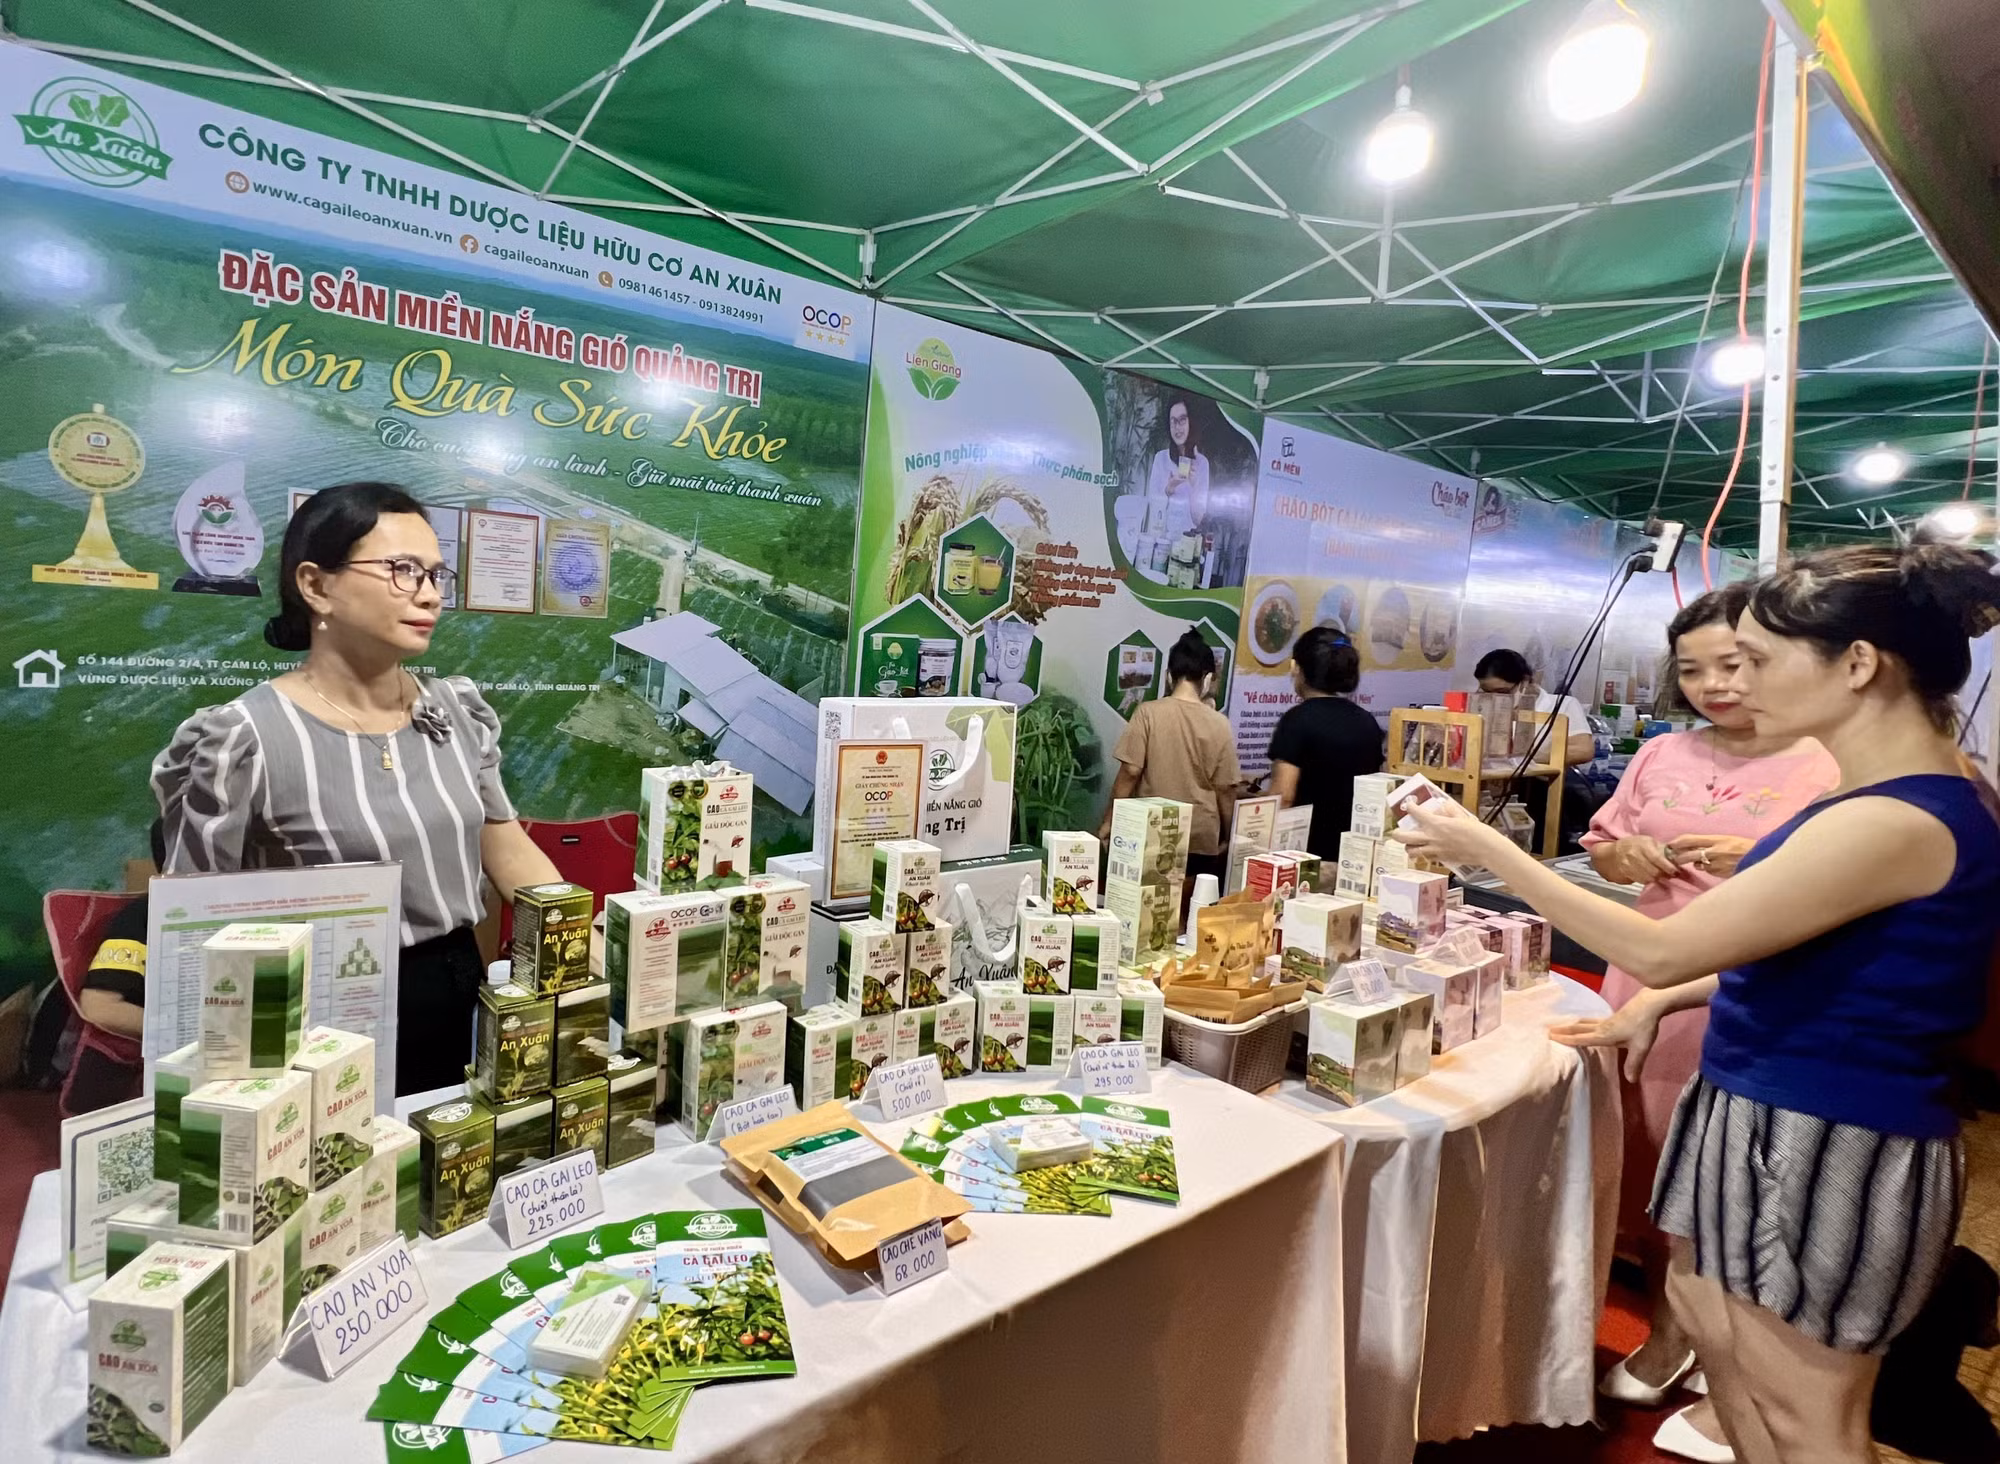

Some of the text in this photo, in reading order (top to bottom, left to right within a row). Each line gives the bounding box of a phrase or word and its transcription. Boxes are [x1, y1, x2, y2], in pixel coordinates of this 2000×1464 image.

[26, 120, 164, 172] An Xuân
[199, 123, 782, 304] CÔNG TY TNHH DƯỢC LIỆU HỮU CƠ AN XUÂN
[253, 179, 764, 324] www.cagaileoanxuan.vn cagaileoanxuan 0981461457 0913824991
[802, 305, 852, 331] OCOP
[221, 252, 760, 407] ĐẶC SẢN MIỀN NẮNG GIÓ QUẢNG TRỊ
[931, 359, 961, 378] Giang
[169, 317, 787, 463] Món Quà Sức Khỏe
[904, 452, 941, 473] Nông
[944, 443, 987, 468] nghiệp
[1061, 464, 1092, 482] phẩm
[1094, 470, 1119, 487] sạch
[737, 481, 780, 502] thanh
[101, 657, 123, 666] 144
[865, 790, 893, 801] OCOP
[706, 804, 720, 814] CAO
[944, 817, 966, 834] Trị
[1059, 855, 1070, 864] CAO
[671, 907, 697, 919] OCOP
[544, 928, 588, 945] An Xuân
[1031, 935, 1042, 943] CAO
[204, 996, 219, 1005] CAO
[500, 1033, 549, 1053] An Xuân
[1080, 1050, 1096, 1060] CAO
[1126, 1047, 1139, 1057] LEO
[879, 1060, 934, 1084] CAO GAI LEO
[1094, 1075, 1133, 1087] 295 000
[326, 1099, 343, 1117] CAO
[724, 1091, 790, 1121] CAO GAI LEO
[892, 1089, 931, 1113] 500 000
[560, 1117, 604, 1139] An Xuân
[267, 1142, 282, 1161] CAO
[440, 1154, 490, 1182] An Xuân
[506, 1183, 530, 1204] CAO
[551, 1169, 570, 1187] GAI
[572, 1160, 593, 1180] LEO
[527, 1198, 586, 1236] 225.000
[309, 1231, 327, 1250] CAO
[683, 1255, 699, 1266] CÀ
[727, 1254, 748, 1264] LEO
[881, 1244, 899, 1264] CAO
[895, 1250, 935, 1282] 68.000
[311, 1249, 412, 1331] CAO AN XOA
[336, 1280, 413, 1356] 250.000
[98, 1353, 121, 1370] CAO
[122, 1361, 136, 1371] AN
